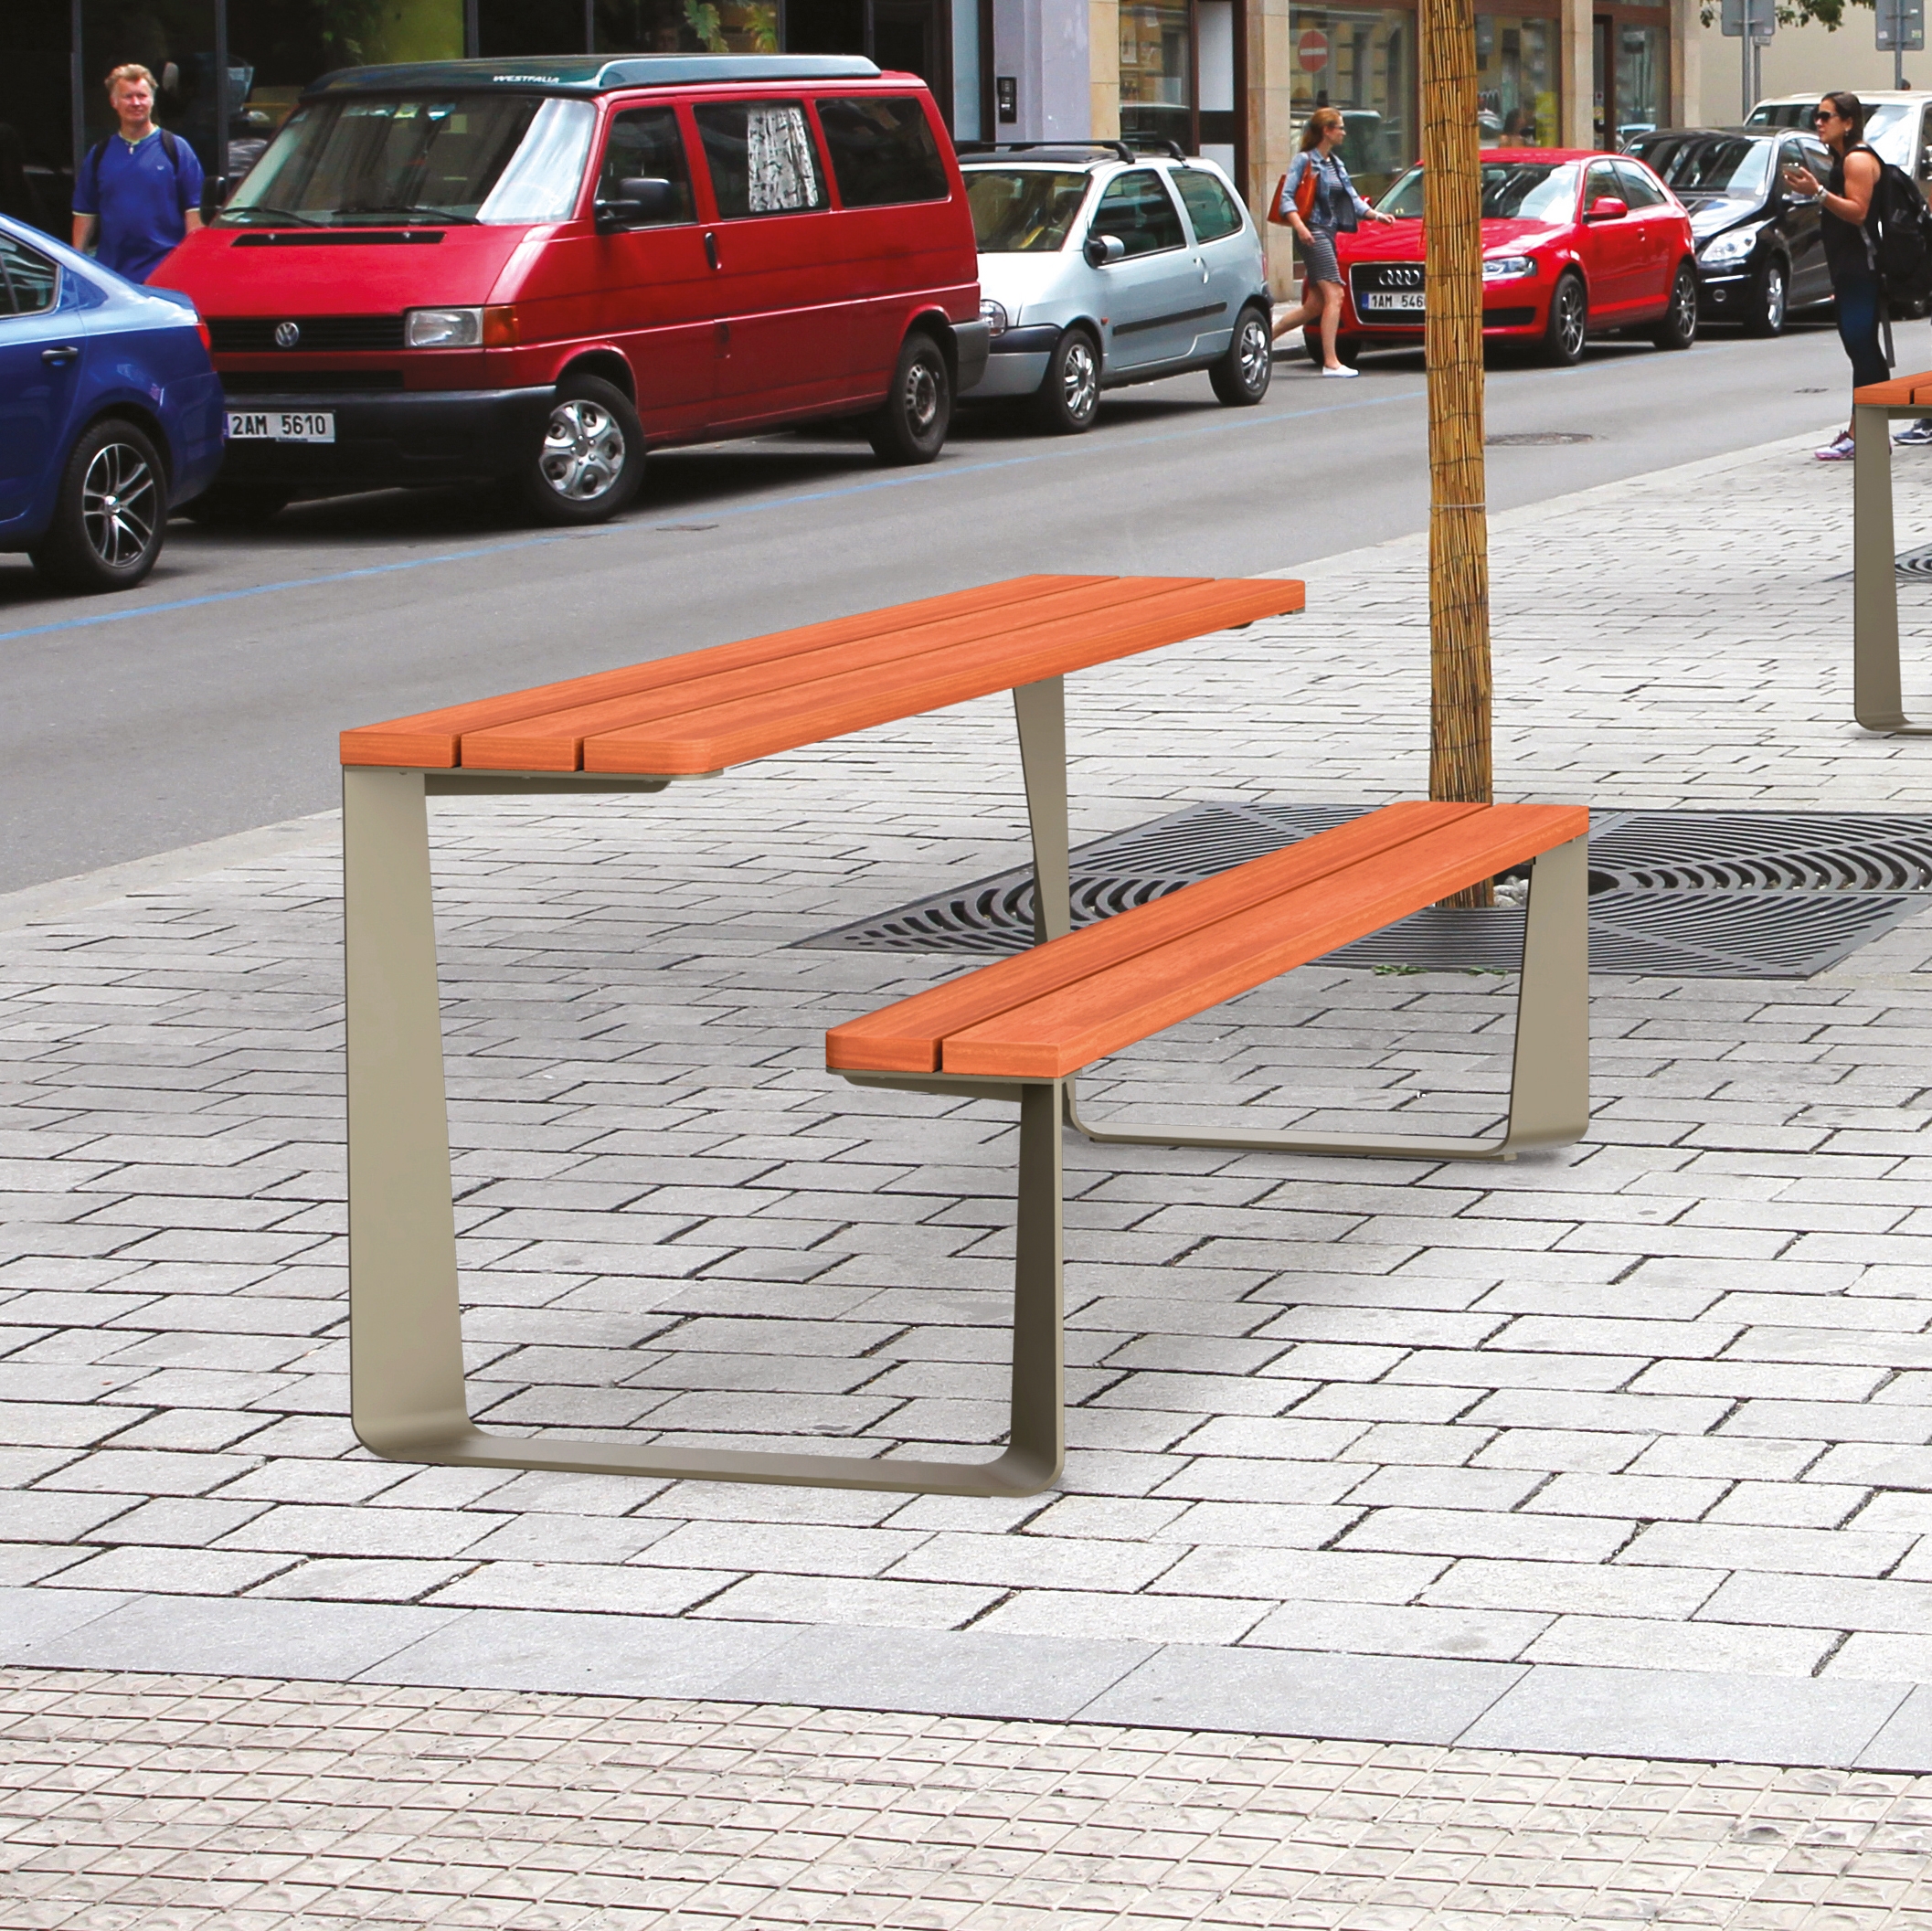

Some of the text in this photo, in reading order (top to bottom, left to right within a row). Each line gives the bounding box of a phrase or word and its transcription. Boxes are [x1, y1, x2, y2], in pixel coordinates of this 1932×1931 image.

[493, 75, 559, 83] WESTFALIA
[1372, 295, 1425, 308] 1AM 546
[232, 415, 326, 435] 2AM 5610
